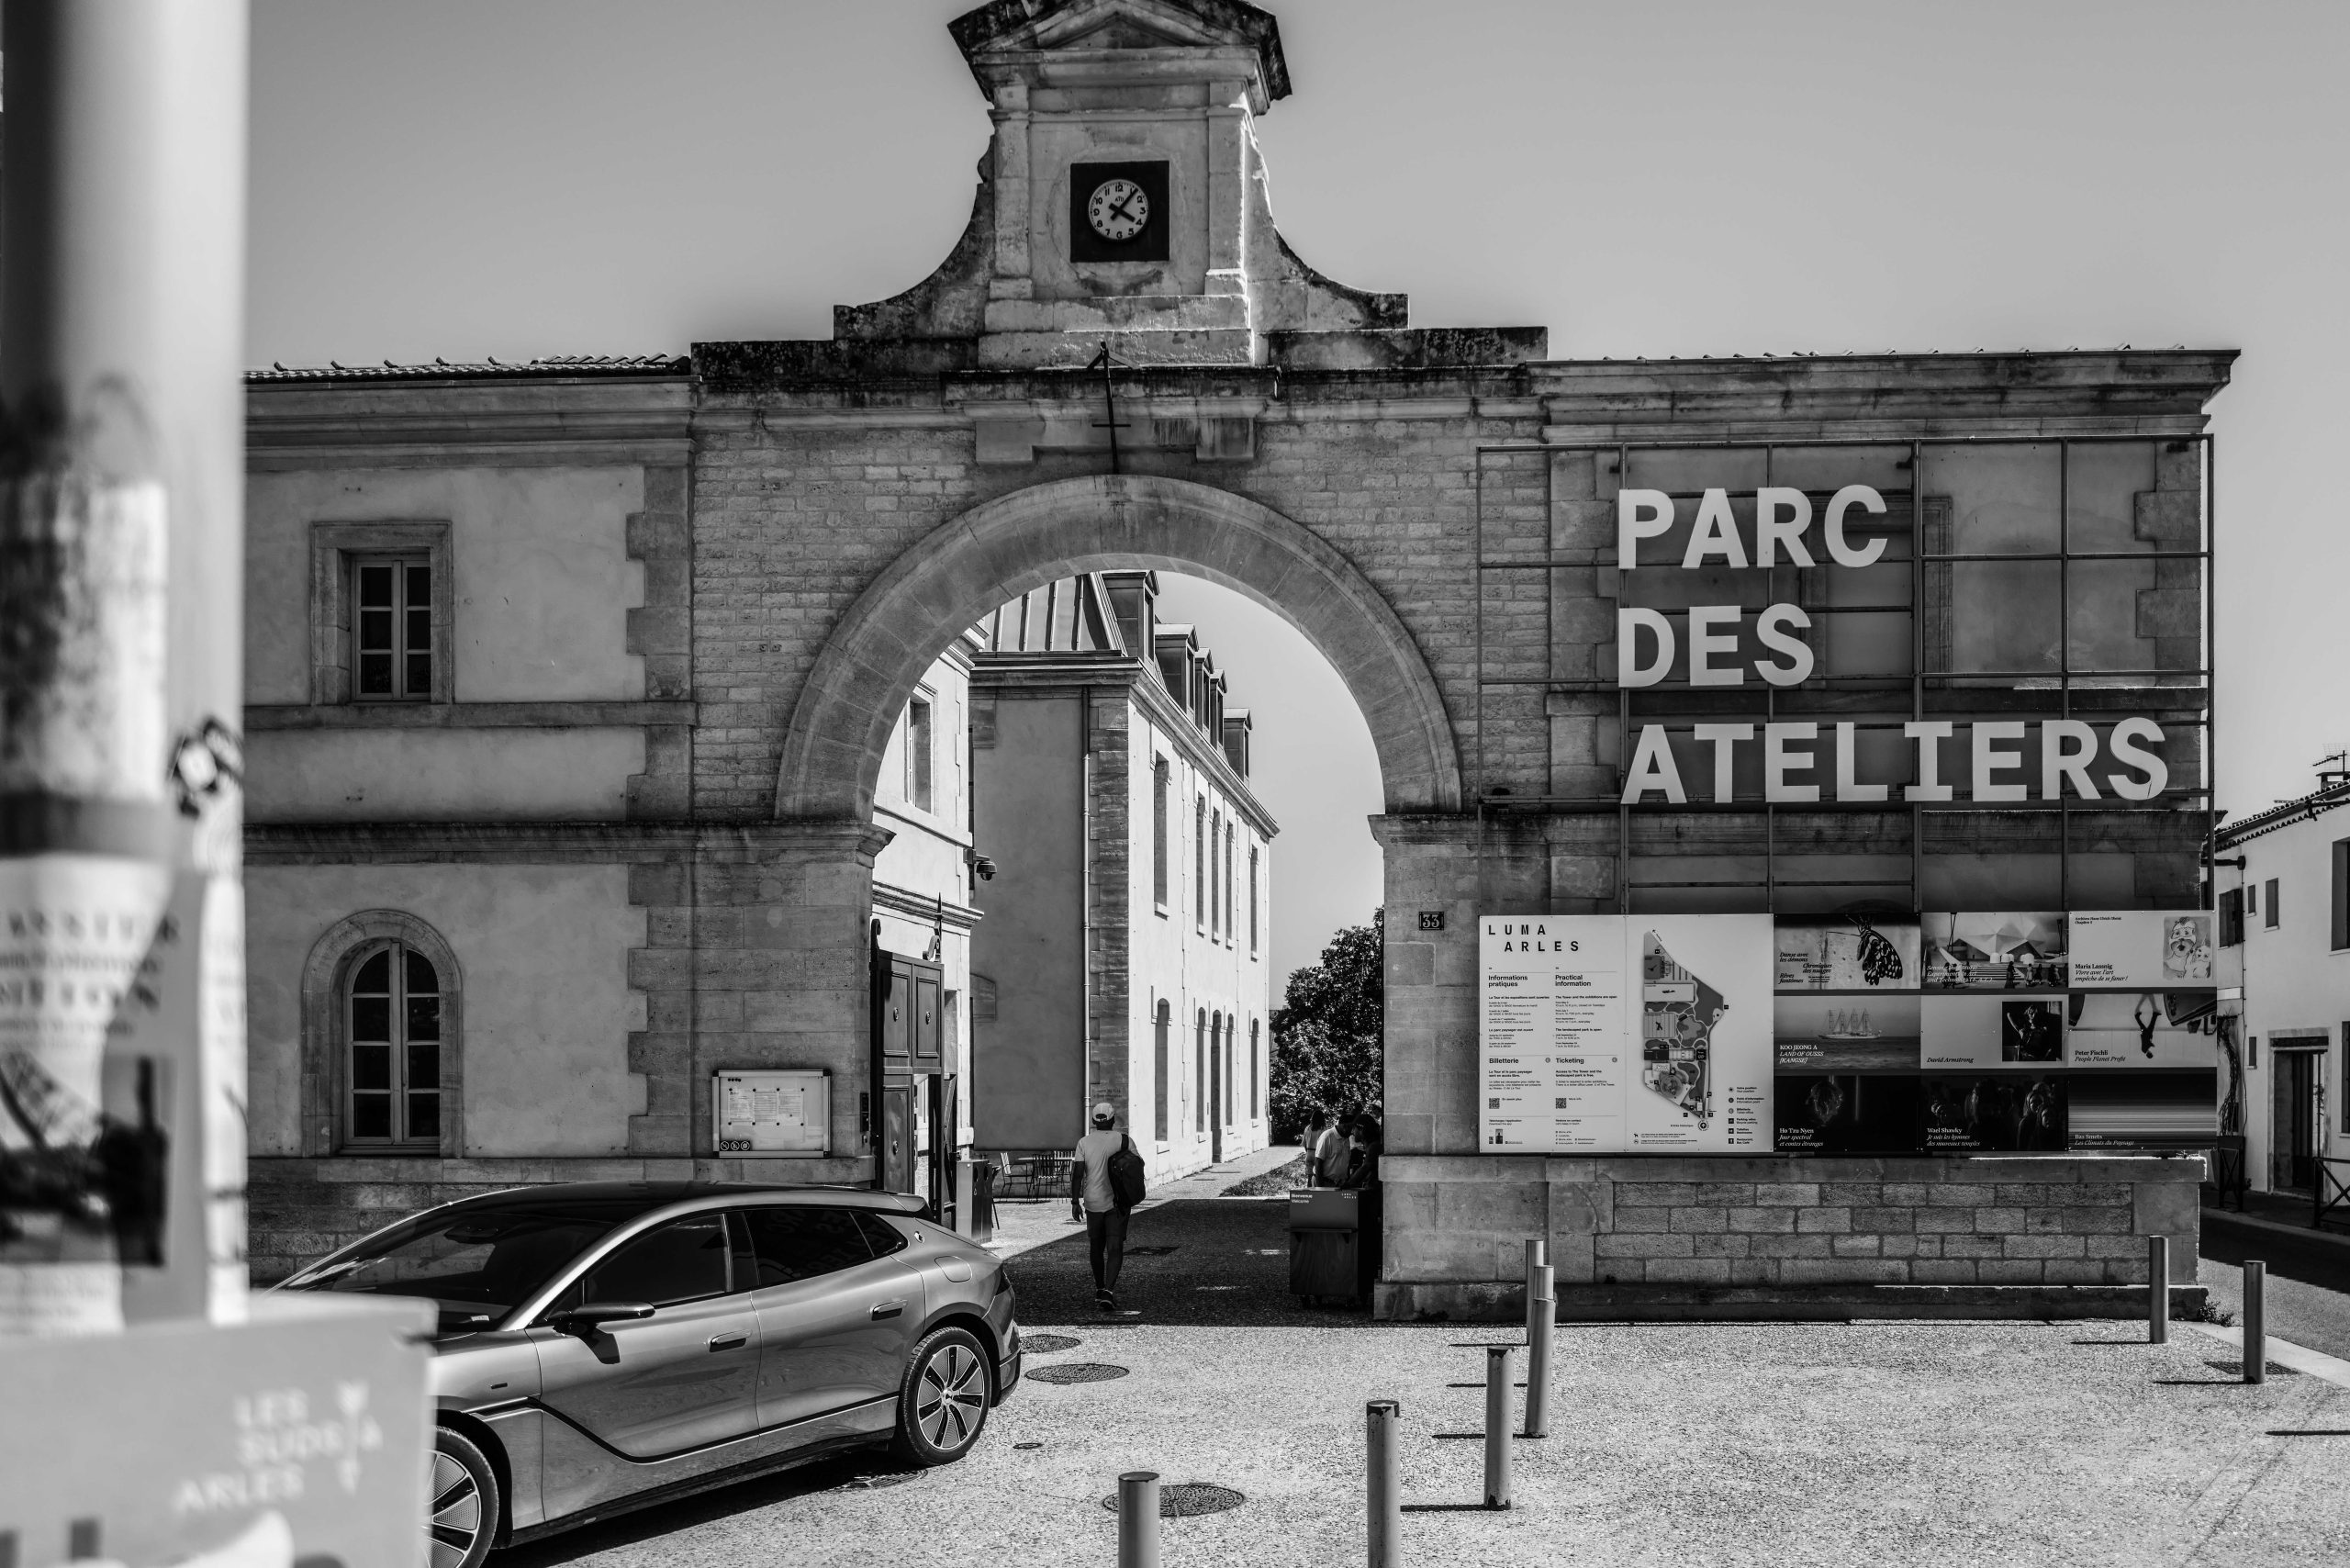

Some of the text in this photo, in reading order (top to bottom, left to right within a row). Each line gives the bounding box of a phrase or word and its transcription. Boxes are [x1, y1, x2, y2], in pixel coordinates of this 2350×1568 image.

[1128, 228, 1135, 236] 5
[1617, 484, 1888, 570] PARC
[1617, 602, 1815, 689] DES
[1619, 717, 2168, 805] ATELIERS
[1422, 913, 1440, 928] 33
[1488, 924, 1546, 935] LUMA
[1504, 941, 1580, 952] ARLES
